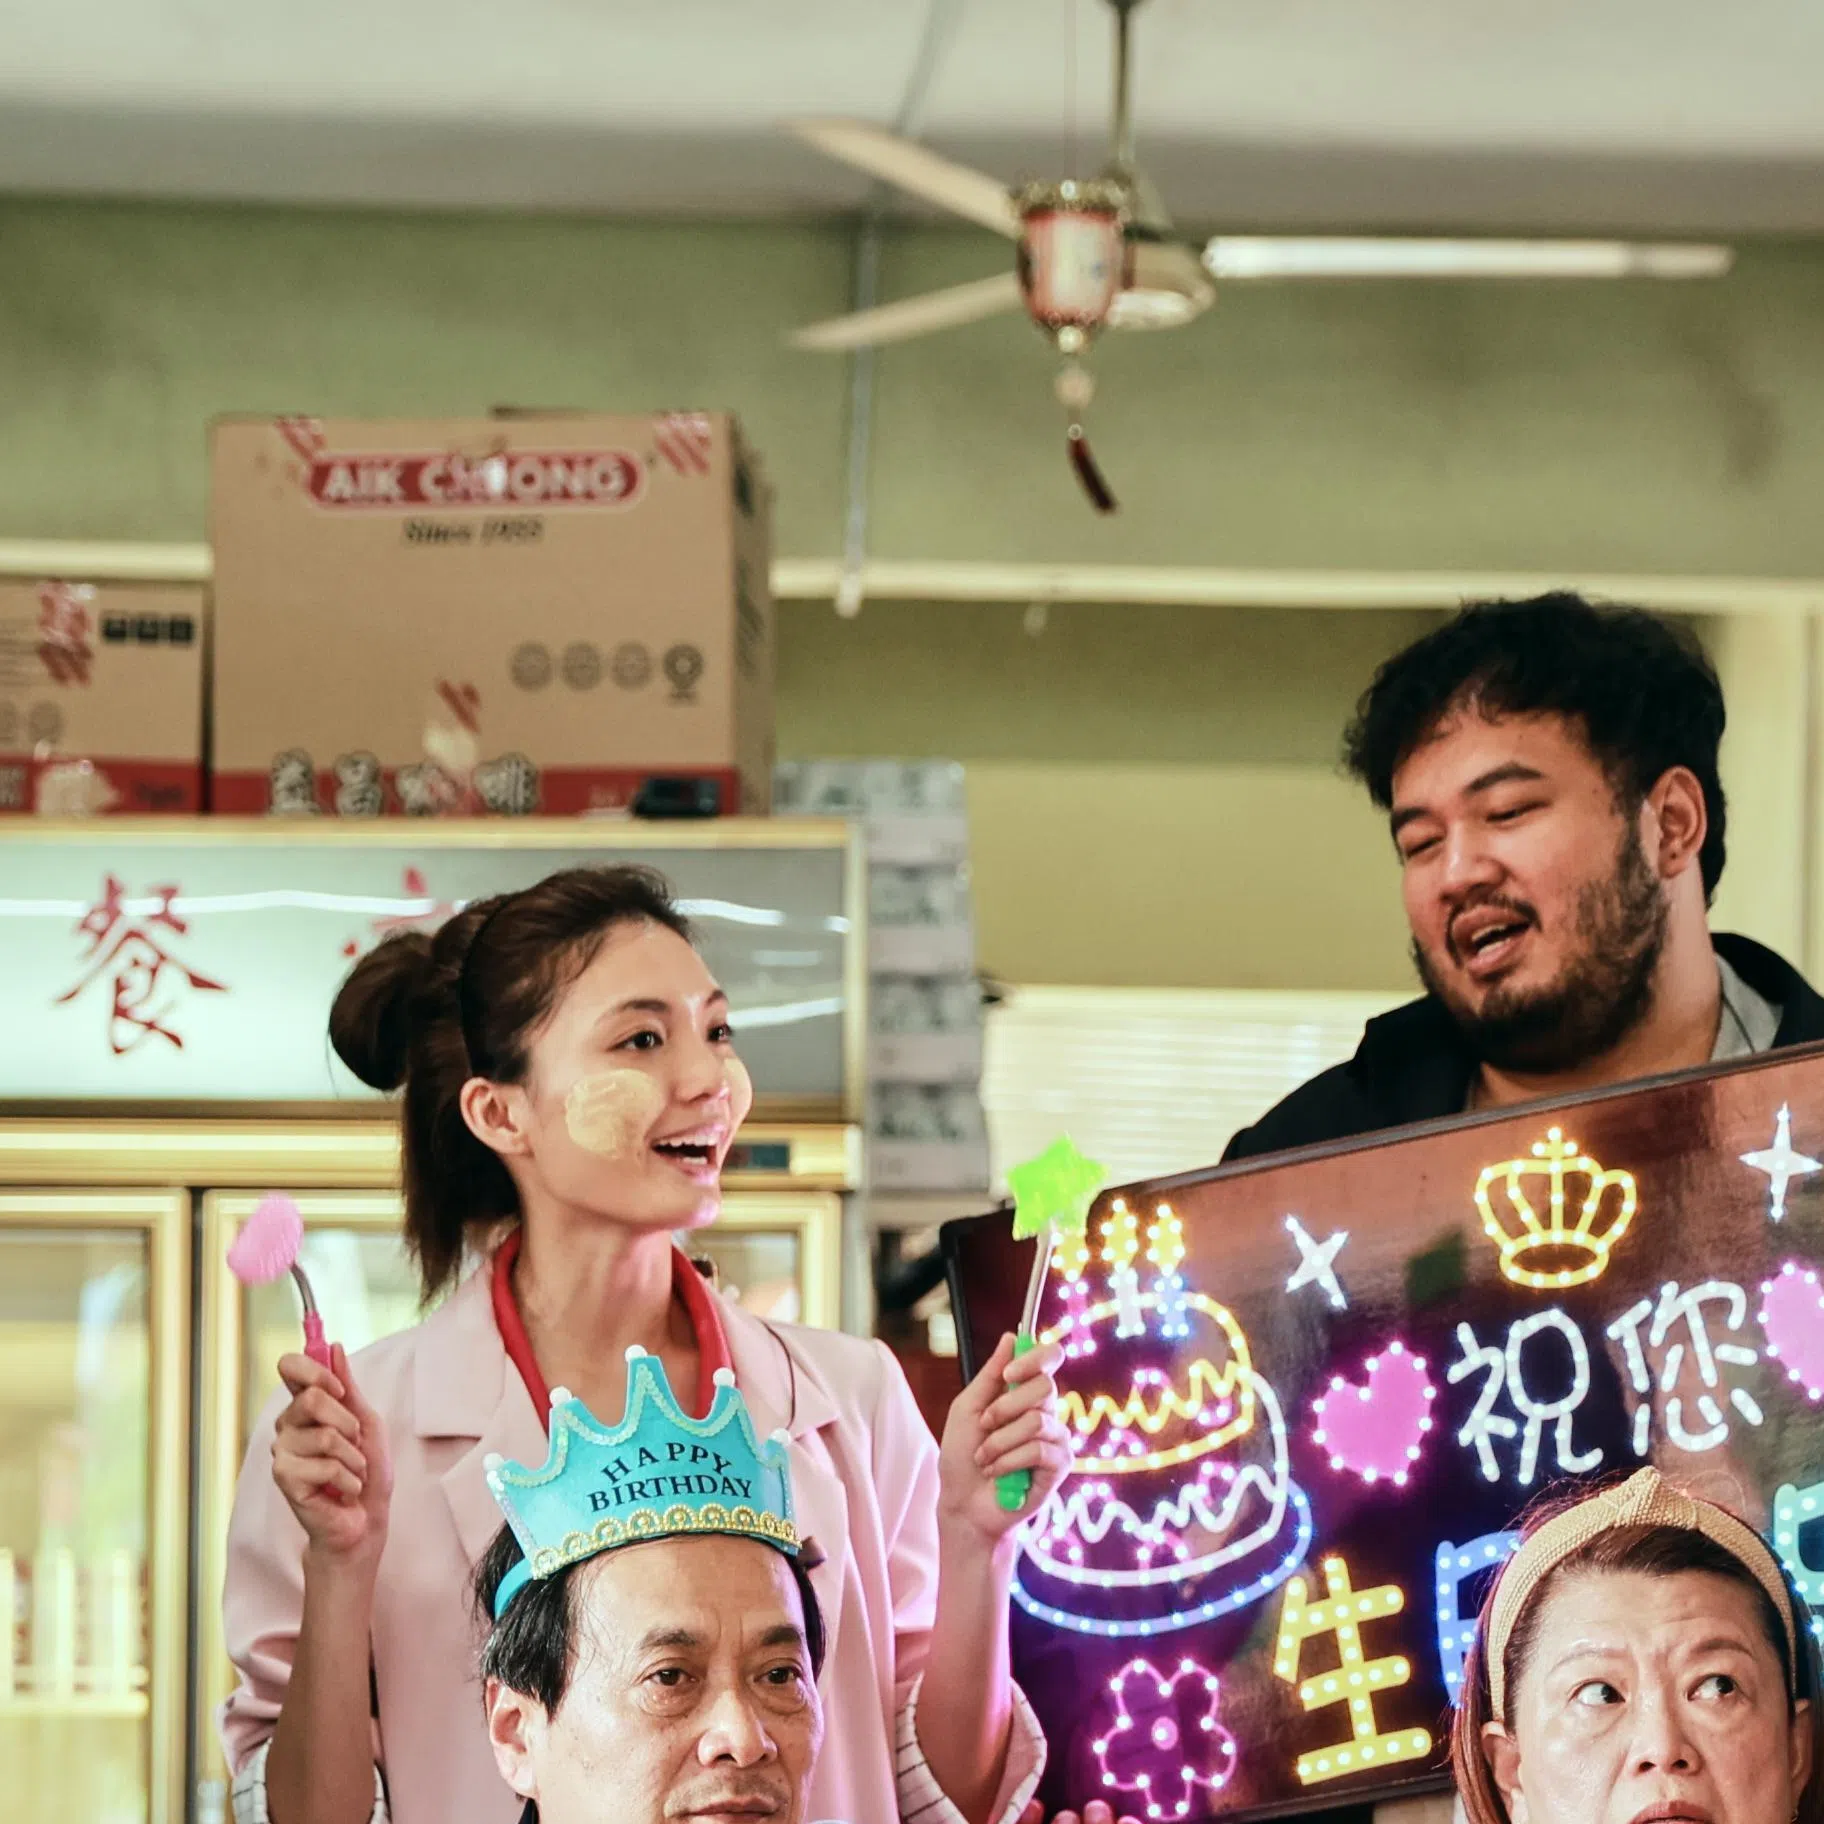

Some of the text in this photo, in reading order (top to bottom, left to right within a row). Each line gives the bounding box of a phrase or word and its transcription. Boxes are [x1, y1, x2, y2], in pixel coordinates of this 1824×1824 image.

[323, 456, 627, 502] AIK CHONG
[1446, 1280, 1764, 1484] 祝您
[600, 1442, 732, 1485] HAPPY
[586, 1474, 753, 1513] BIRTHDAY
